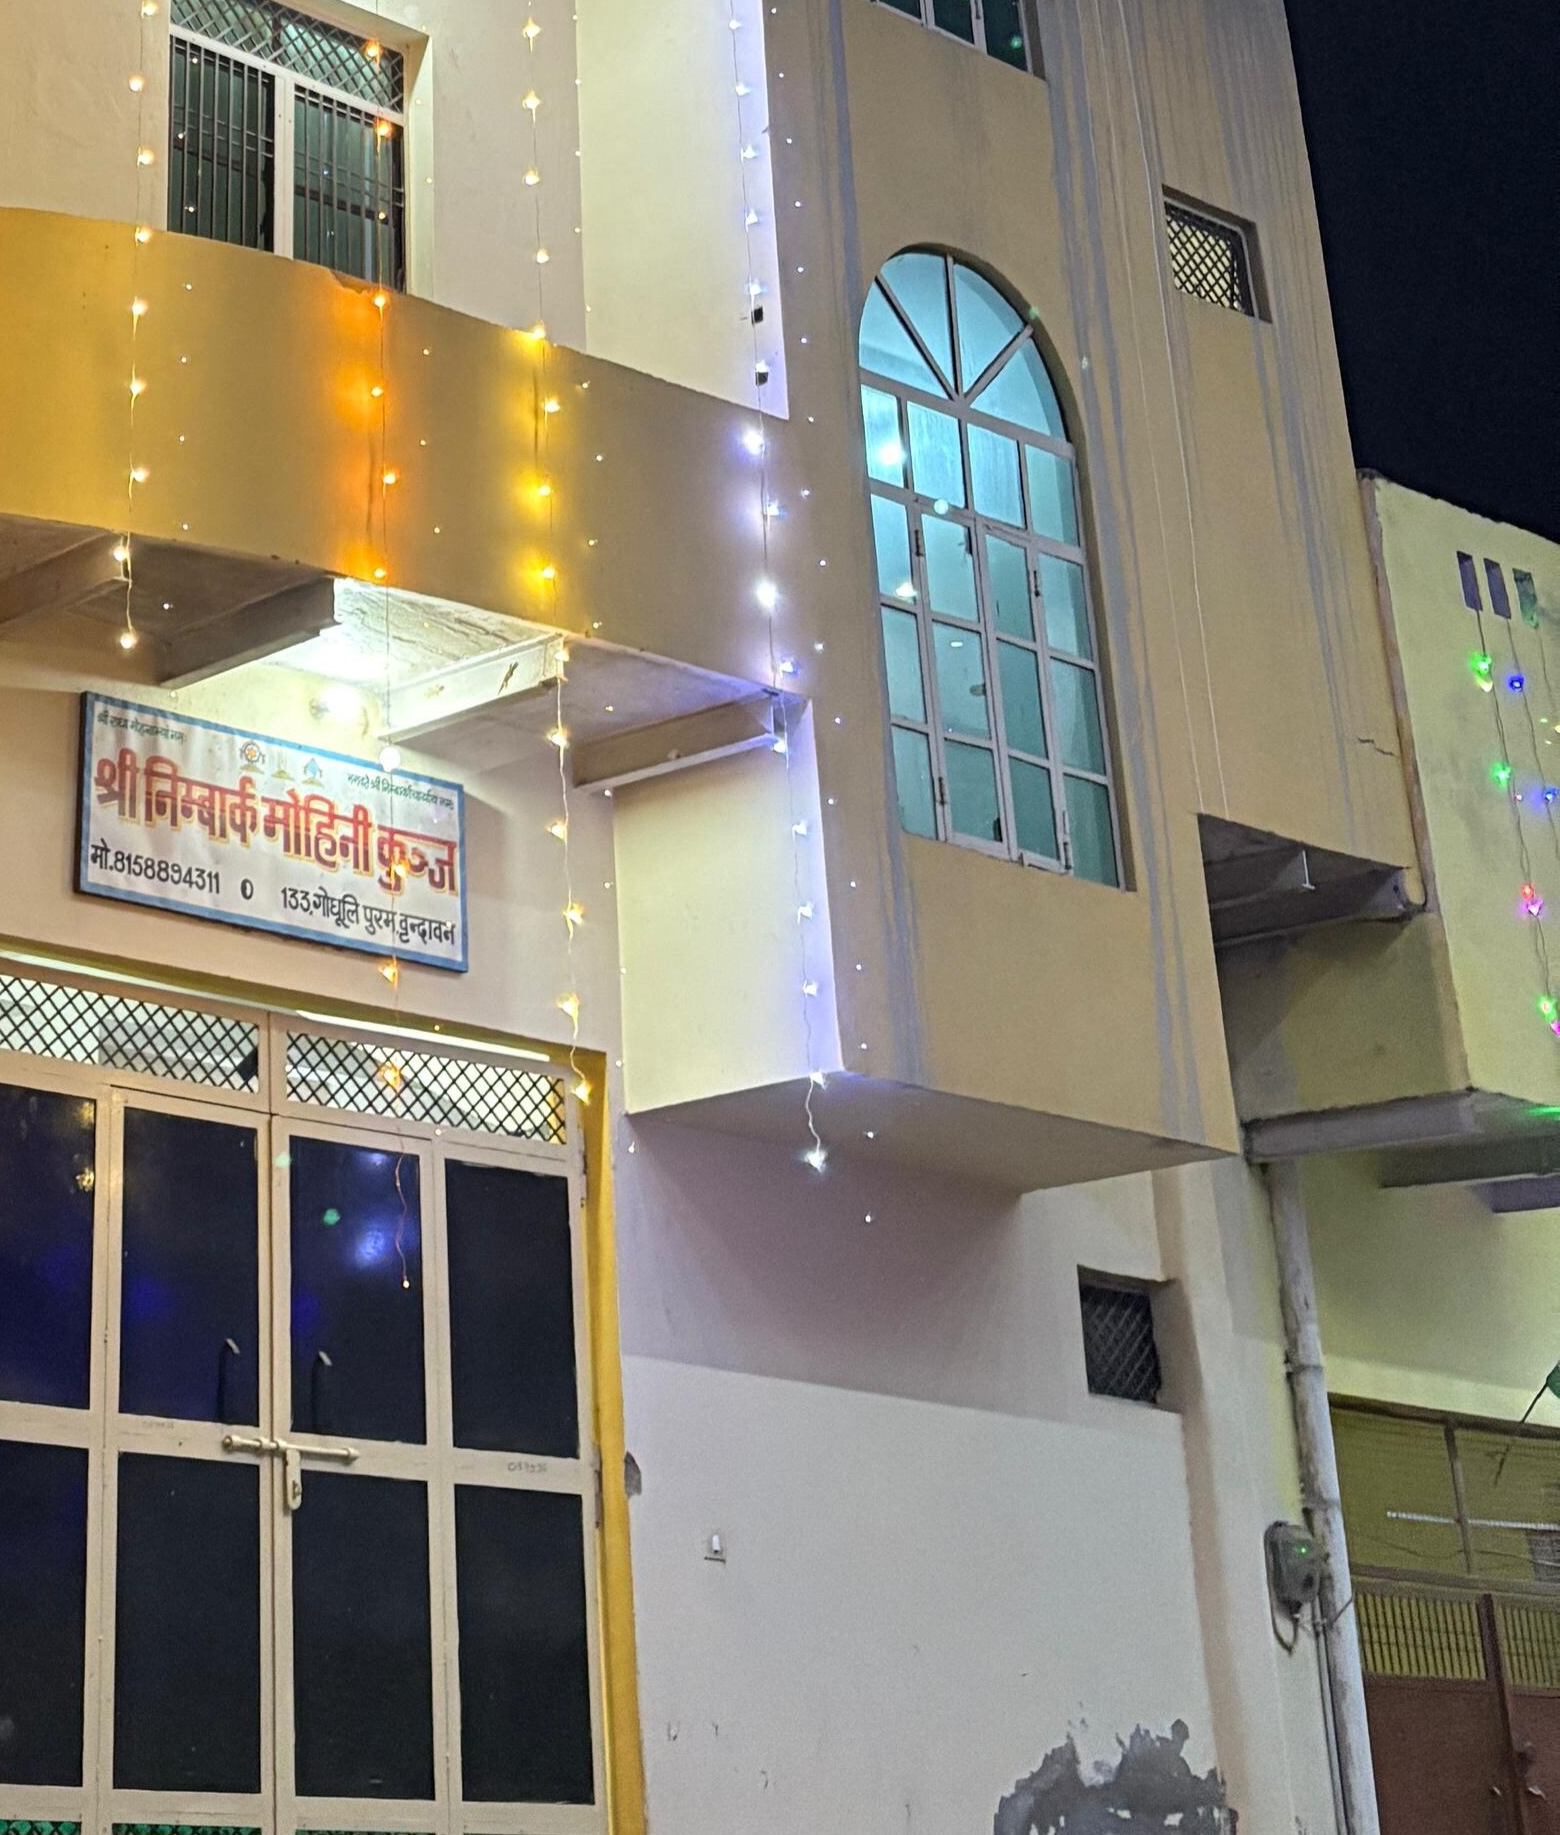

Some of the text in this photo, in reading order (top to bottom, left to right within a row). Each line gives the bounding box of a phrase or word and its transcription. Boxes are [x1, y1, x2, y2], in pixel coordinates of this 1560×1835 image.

[94, 747, 139, 821] श्री
[144, 755, 260, 847] निम्बार्क
[261, 788, 373, 872] मोहिनी
